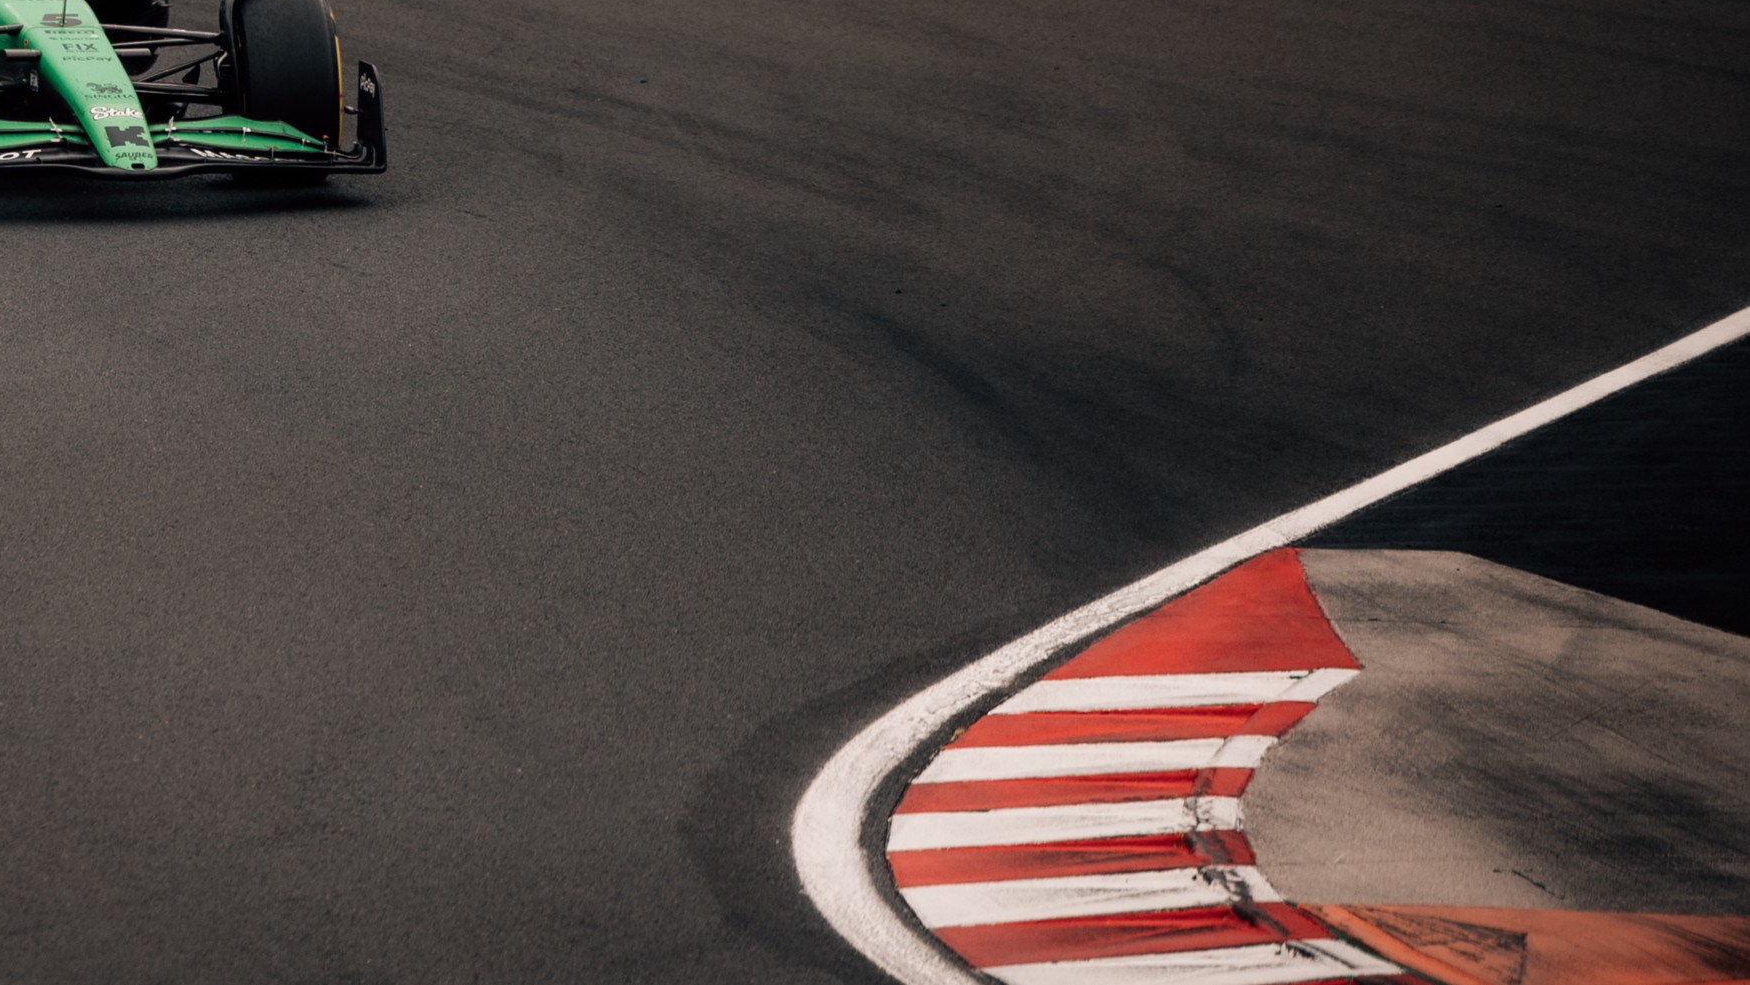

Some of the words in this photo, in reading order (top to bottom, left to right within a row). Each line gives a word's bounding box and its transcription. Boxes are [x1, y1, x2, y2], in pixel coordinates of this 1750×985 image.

[40, 14, 82, 27] 5
[62, 43, 98, 51] FIX
[90, 106, 143, 120] Stake
[104, 126, 150, 148] K
[115, 151, 153, 161] SAUBER
